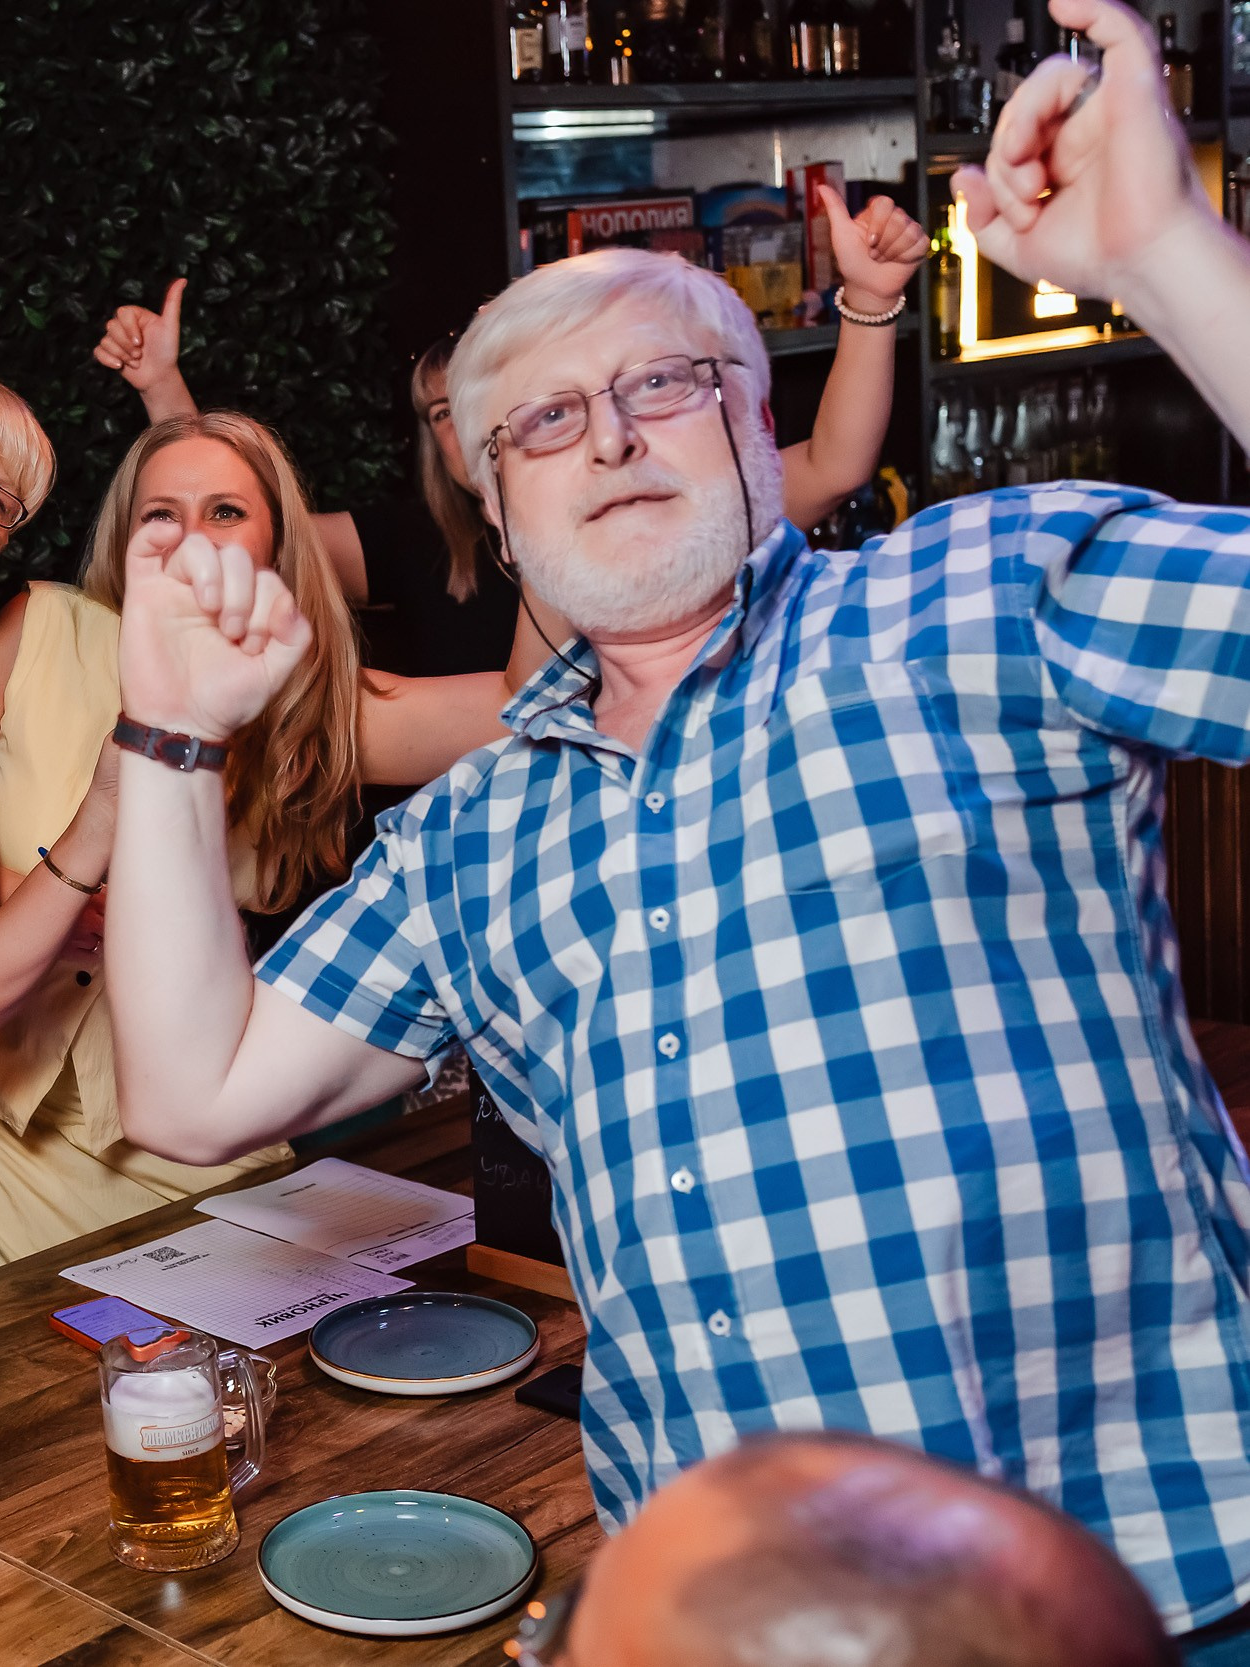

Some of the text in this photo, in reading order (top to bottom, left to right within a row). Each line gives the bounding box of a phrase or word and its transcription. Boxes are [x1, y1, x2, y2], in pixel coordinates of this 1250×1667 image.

[581, 206, 689, 238] НОПОЛИЯ
[255, 1292, 350, 1328] ЧЕРНОВИК
[182, 1447, 199, 1456] since
